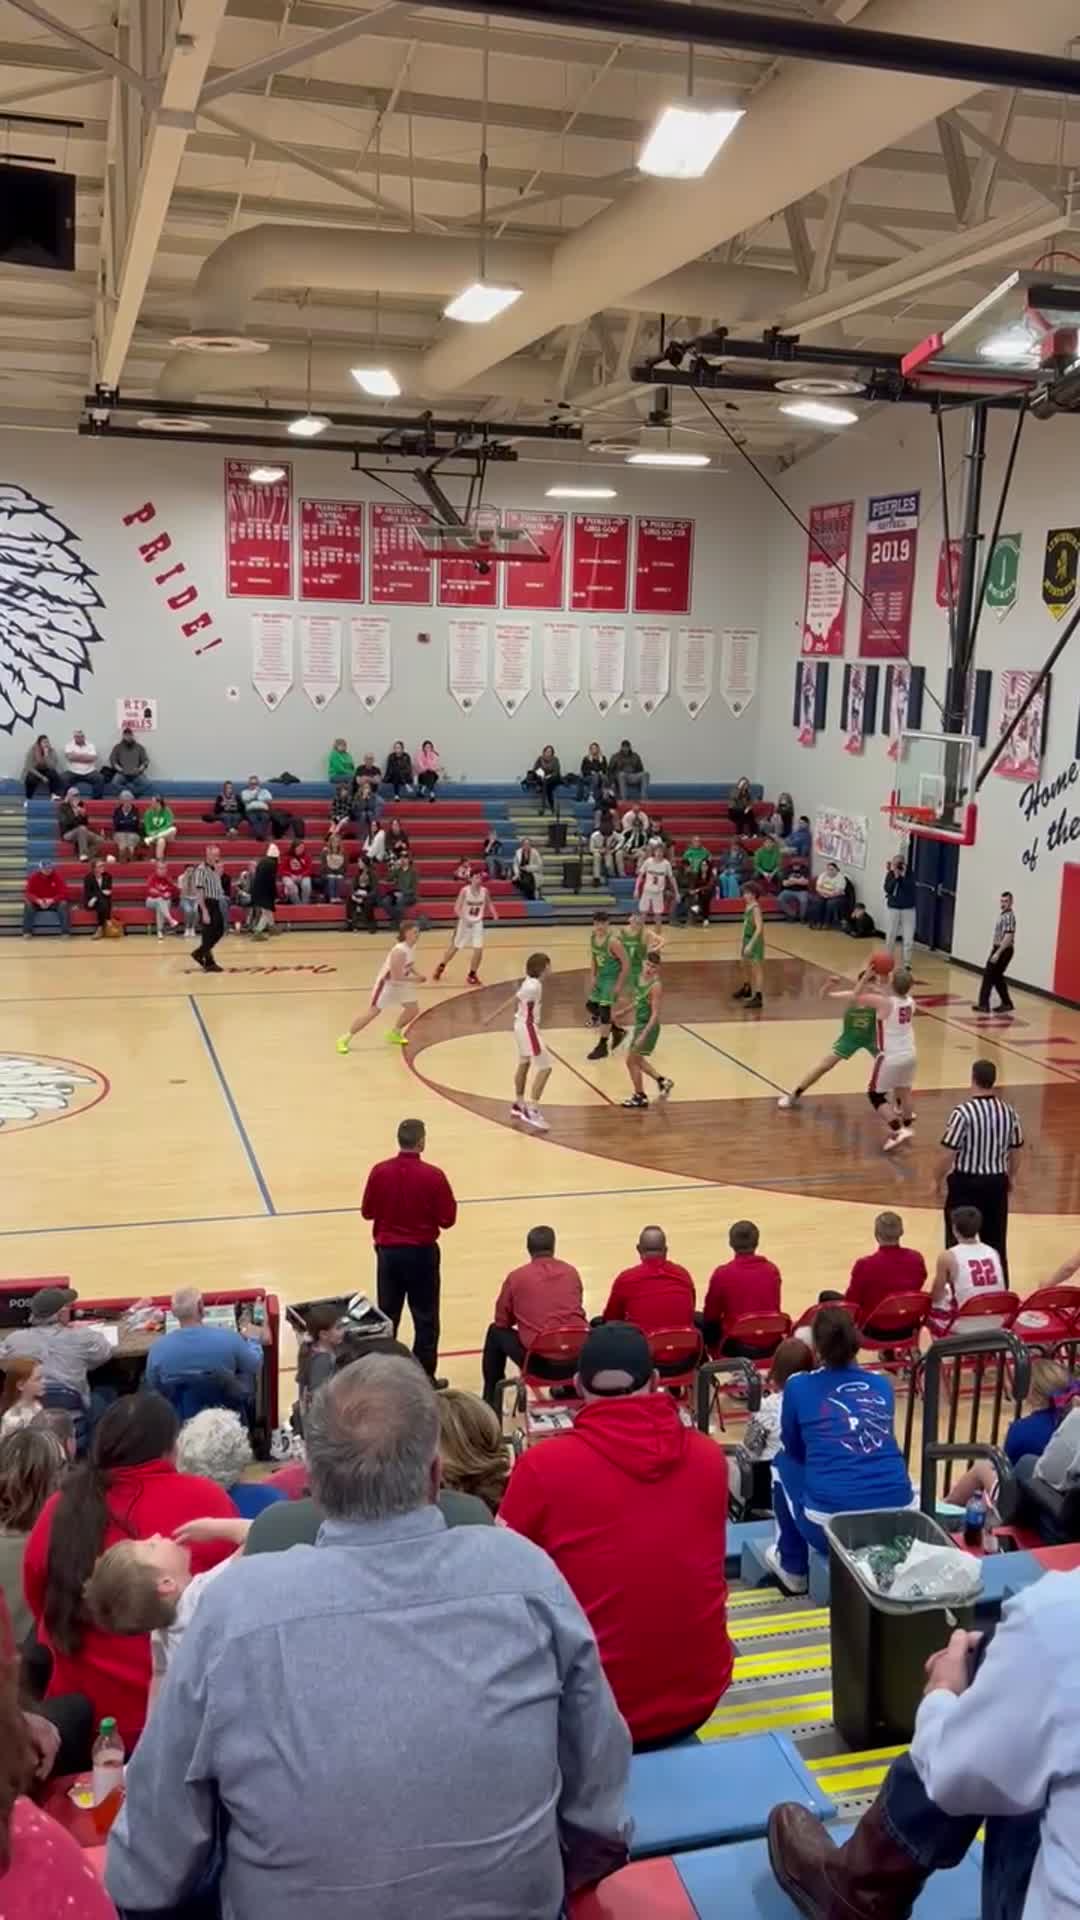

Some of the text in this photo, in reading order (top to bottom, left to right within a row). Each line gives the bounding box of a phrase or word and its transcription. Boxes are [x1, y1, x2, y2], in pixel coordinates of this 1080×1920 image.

[872, 497, 916, 518] PEEBLES
[872, 539, 910, 565] 2019
[122, 502, 223, 656] PRIDE!
[1019, 763, 1079, 821] Home
[1022, 808, 1080, 872] of the
[968, 1259, 997, 1286] 22
[9, 1298, 33, 1309] POS
